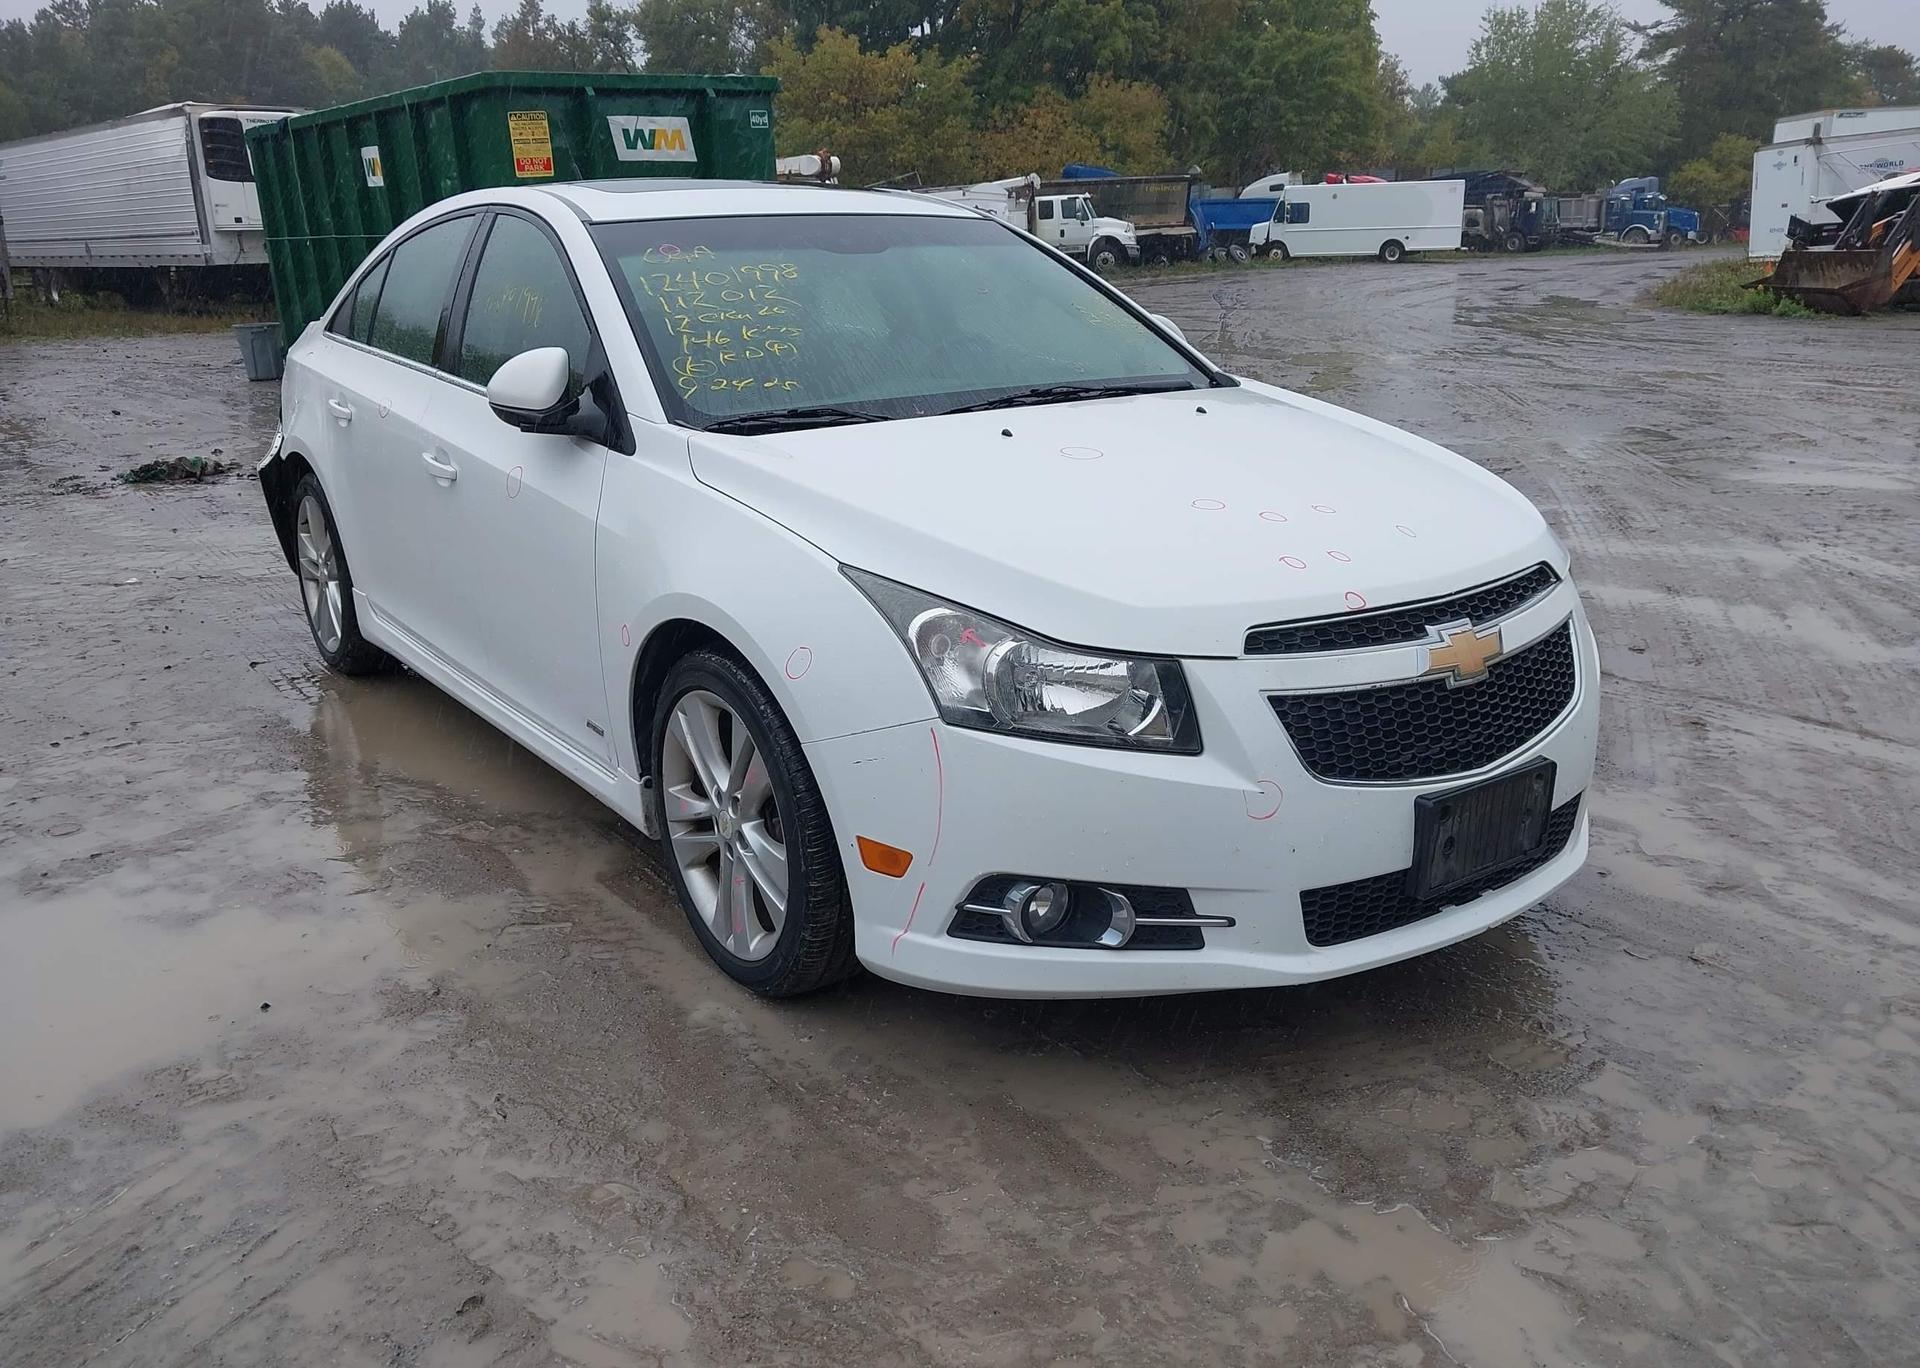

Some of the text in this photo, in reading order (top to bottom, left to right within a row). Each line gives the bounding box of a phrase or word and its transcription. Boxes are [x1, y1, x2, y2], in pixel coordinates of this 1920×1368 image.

[516, 112, 546, 121] CAUTION
[622, 128, 686, 151] WM
[532, 157, 548, 165] NOT
[1876, 160, 1904, 168] WORLD
[524, 164, 545, 172] PARK
[639, 263, 798, 296] 12401998
[683, 330, 731, 355] 146
